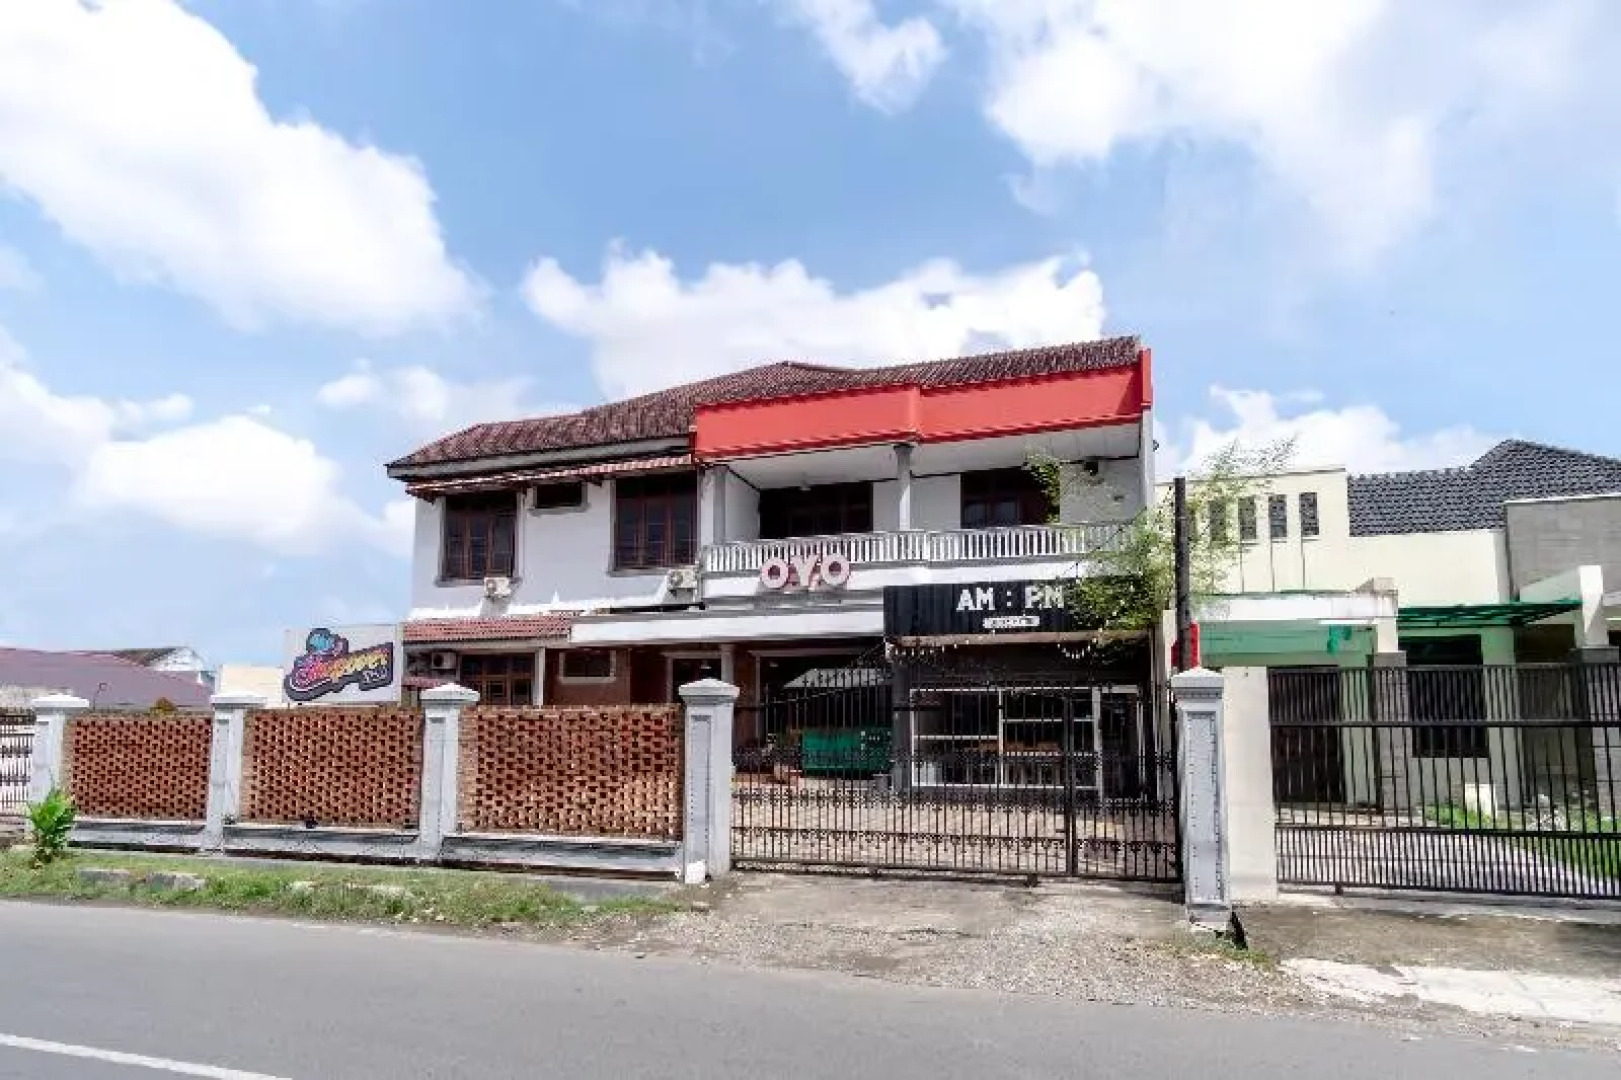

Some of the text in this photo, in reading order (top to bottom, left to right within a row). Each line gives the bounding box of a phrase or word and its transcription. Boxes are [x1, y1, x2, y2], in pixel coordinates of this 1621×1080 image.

[761, 553, 850, 589] OYO
[956, 587, 995, 611] AM
[1024, 585, 1065, 609] PM
